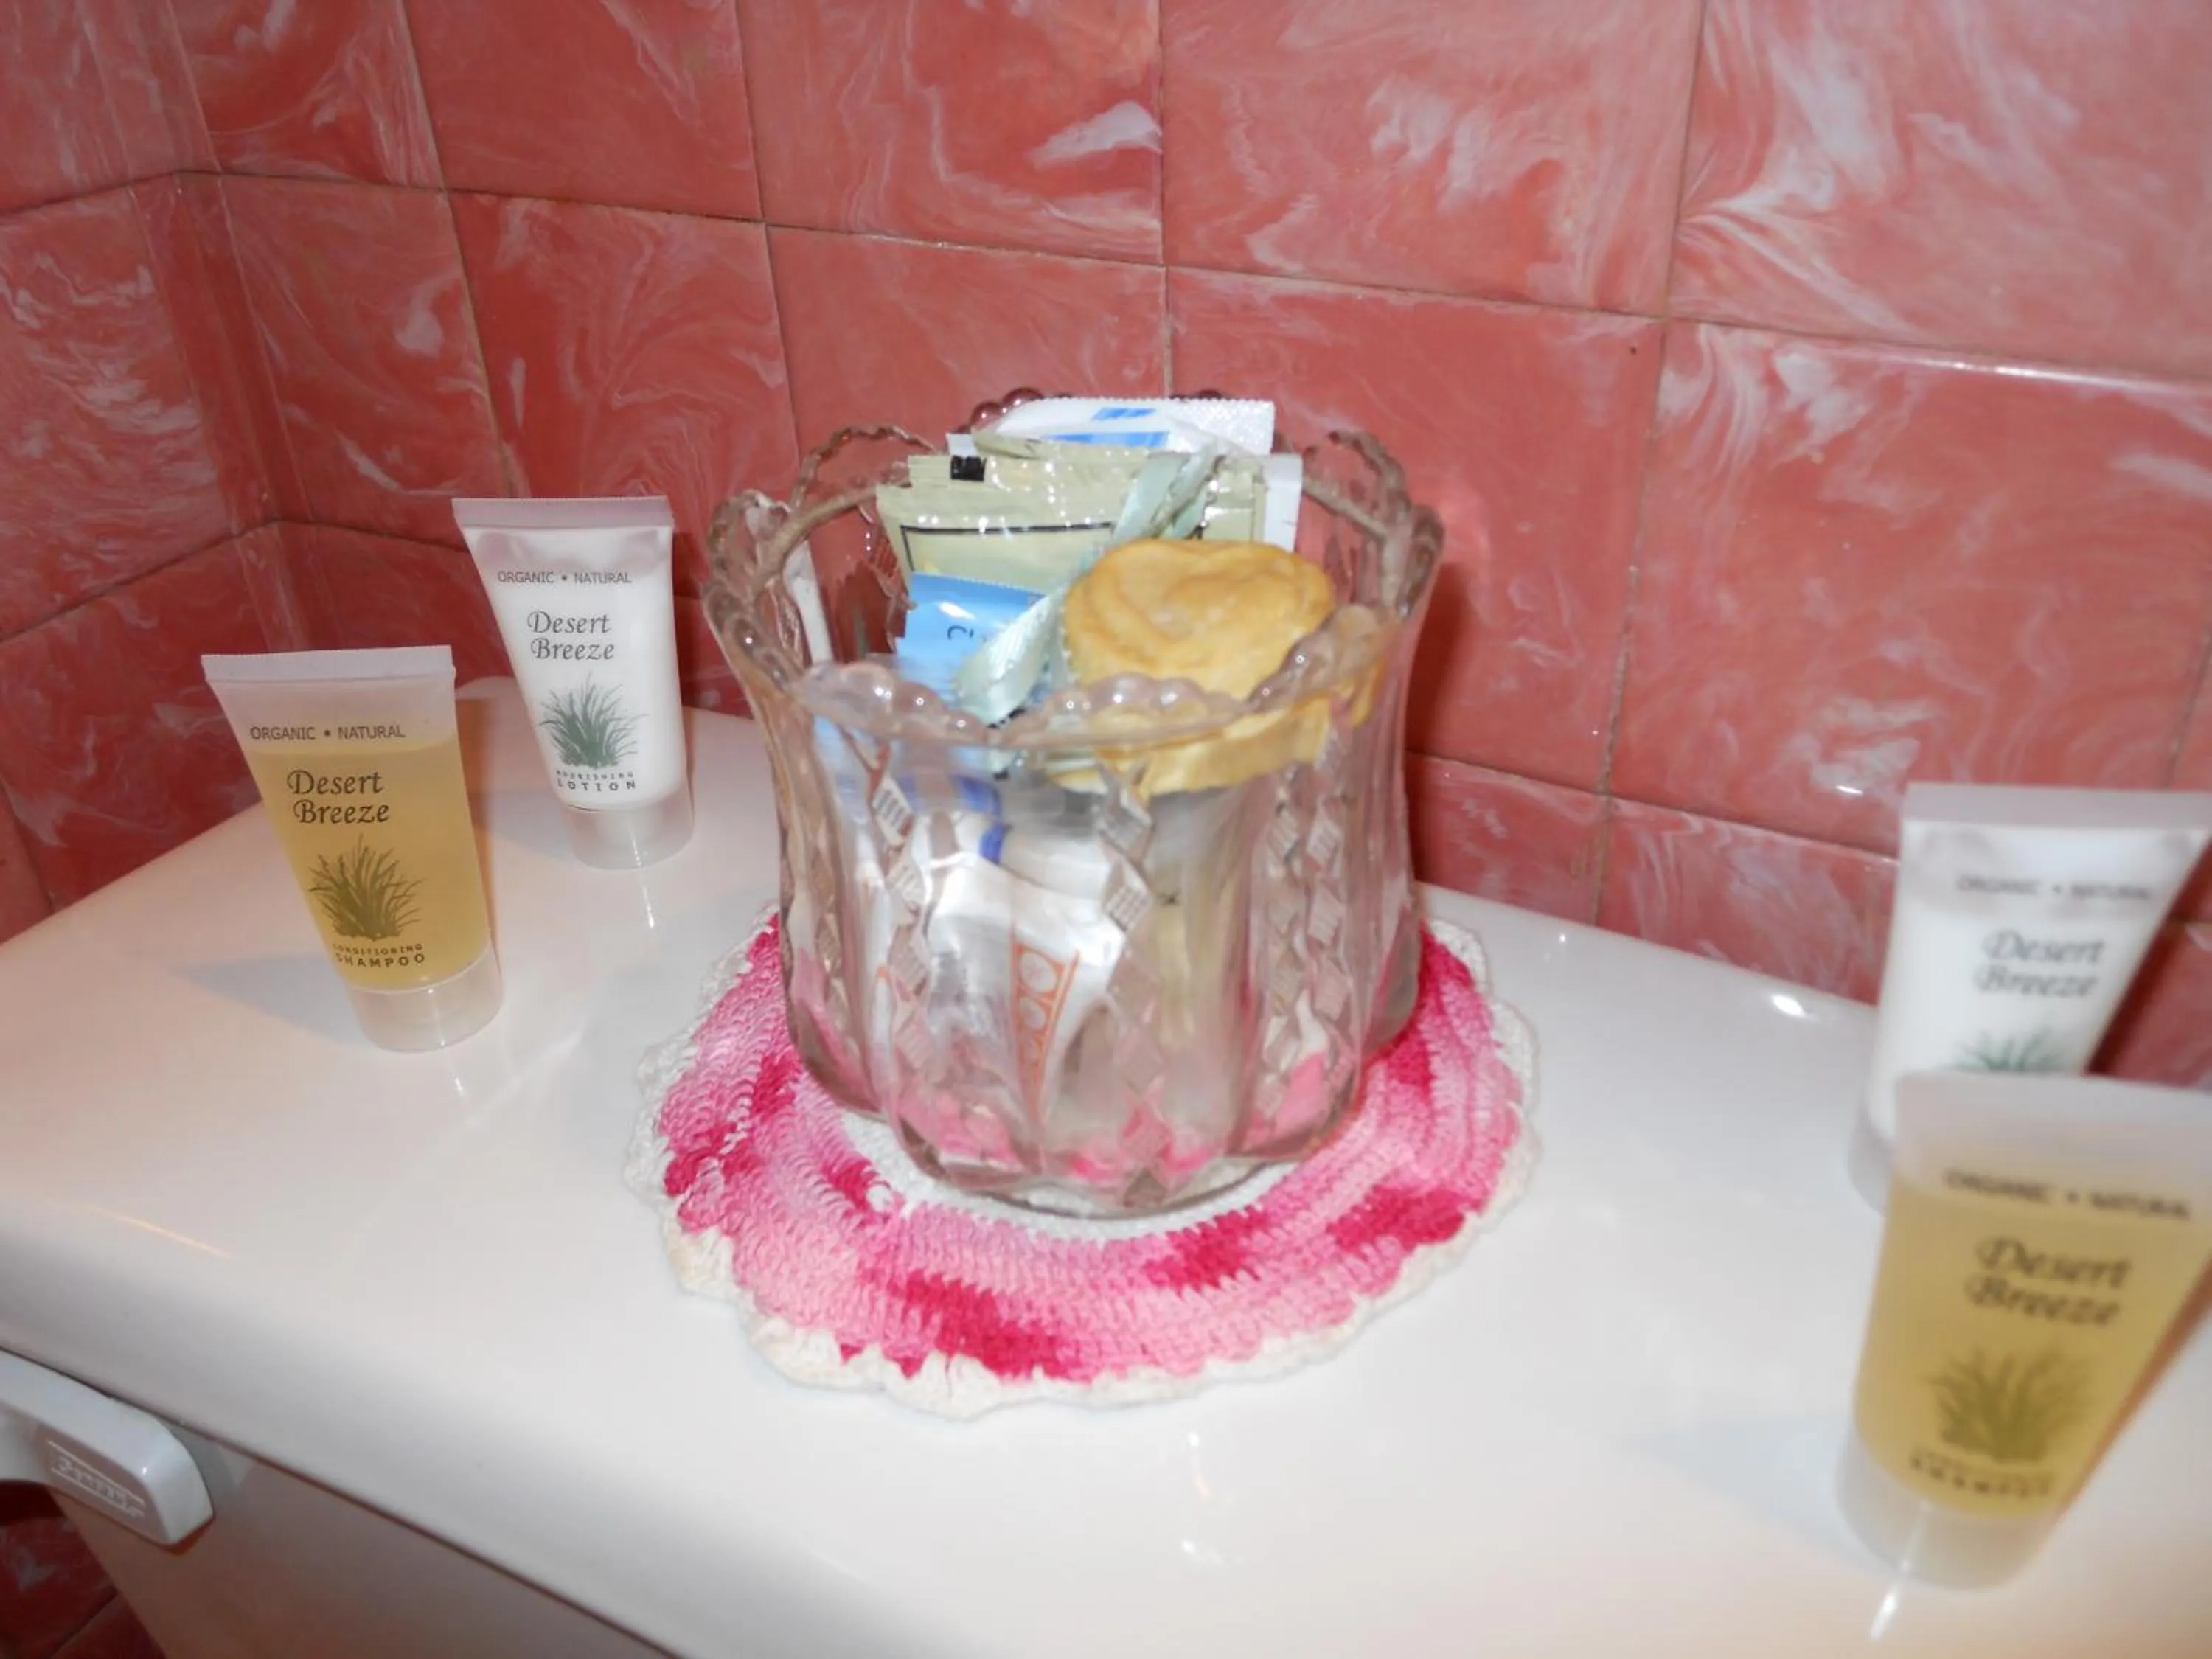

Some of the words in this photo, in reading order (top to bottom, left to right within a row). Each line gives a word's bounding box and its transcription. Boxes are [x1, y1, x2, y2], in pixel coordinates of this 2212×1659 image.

[498, 571, 554, 583] ORGANIC
[574, 571, 632, 584] NATURAL
[527, 610, 612, 634] Desert
[531, 637, 615, 660] Breeze
[249, 726, 316, 740] ORGANIC
[338, 724, 406, 740] NATURAL
[287, 769, 383, 794] Desert
[557, 779, 636, 792] LOTION
[293, 799, 389, 824] Breeze
[335, 952, 425, 968] SHAMPOO
